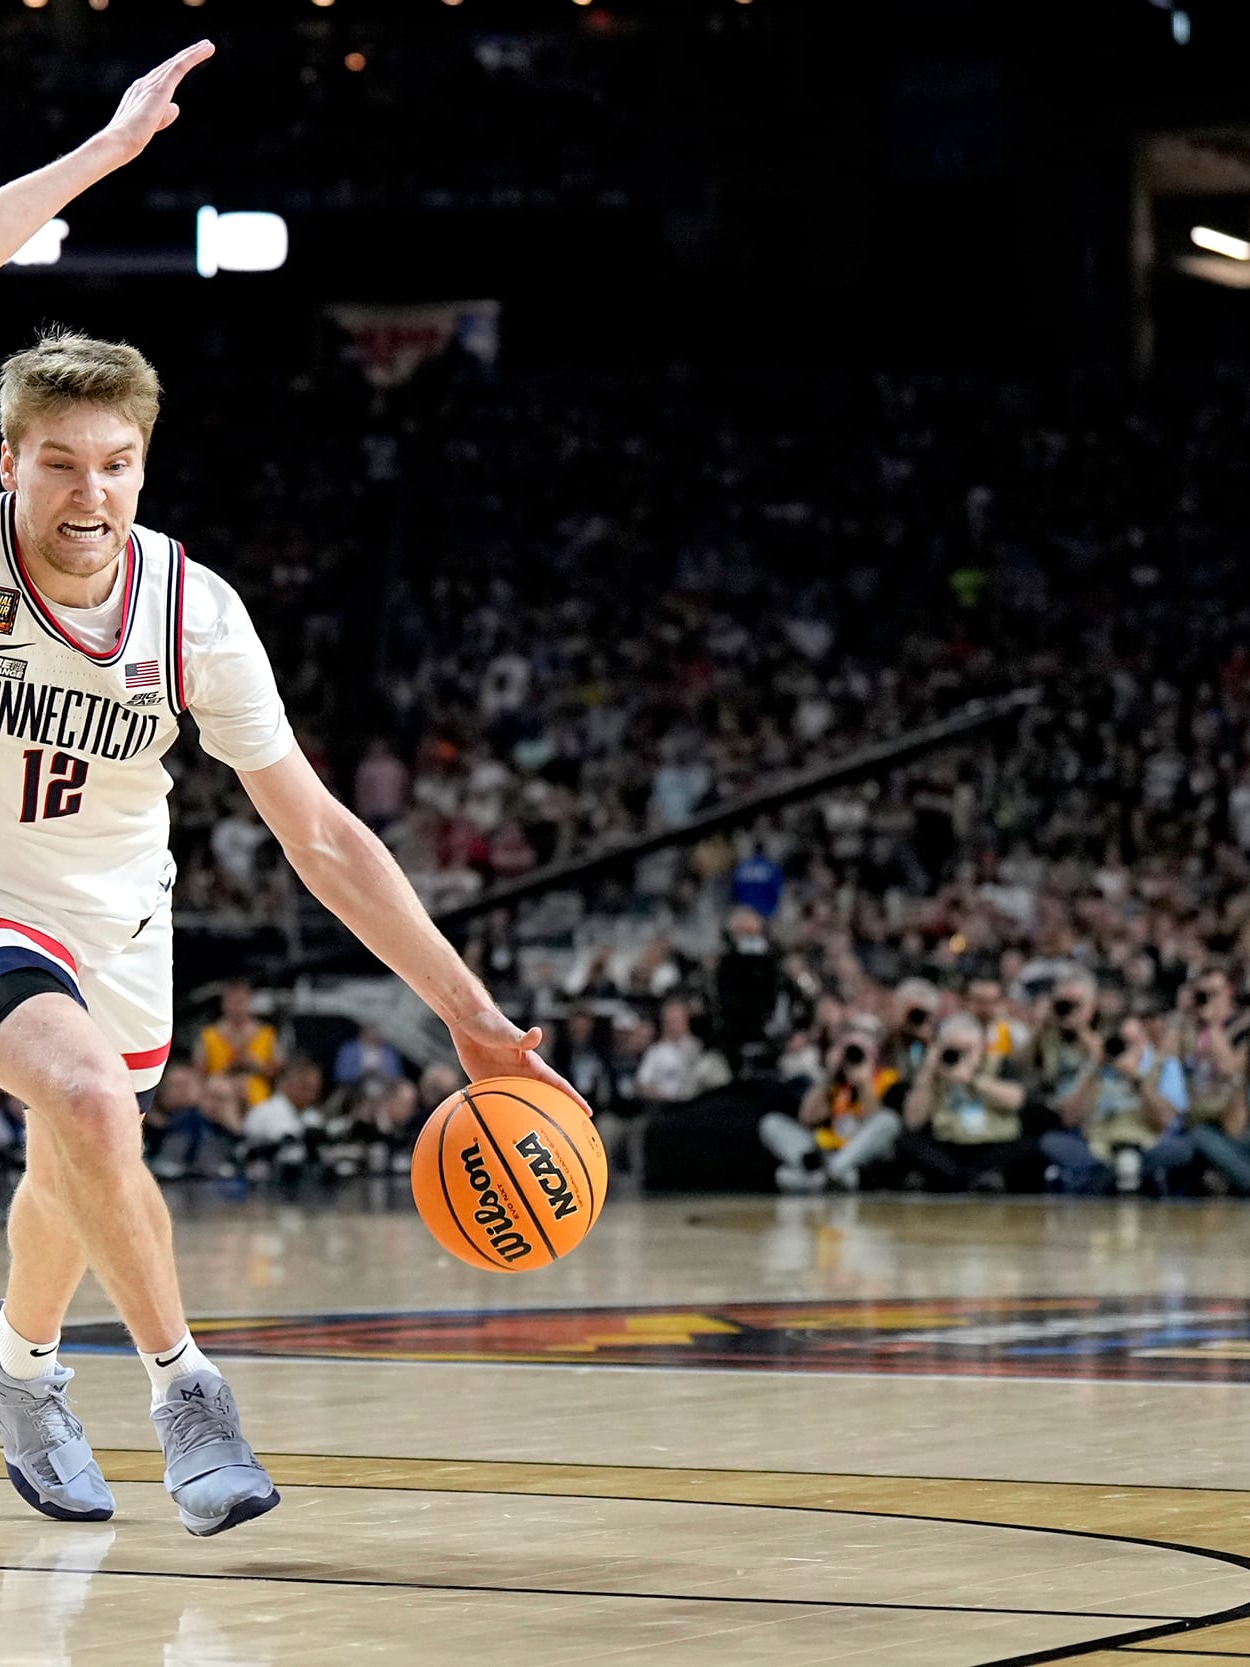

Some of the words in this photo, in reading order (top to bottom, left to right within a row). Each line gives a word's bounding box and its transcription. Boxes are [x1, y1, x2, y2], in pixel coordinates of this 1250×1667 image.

[125, 697, 166, 706] EAST
[131, 691, 159, 701] BIG
[19, 748, 90, 823] 12
[461, 1142, 533, 1263] Wilson
[514, 1131, 578, 1220] NCAA
